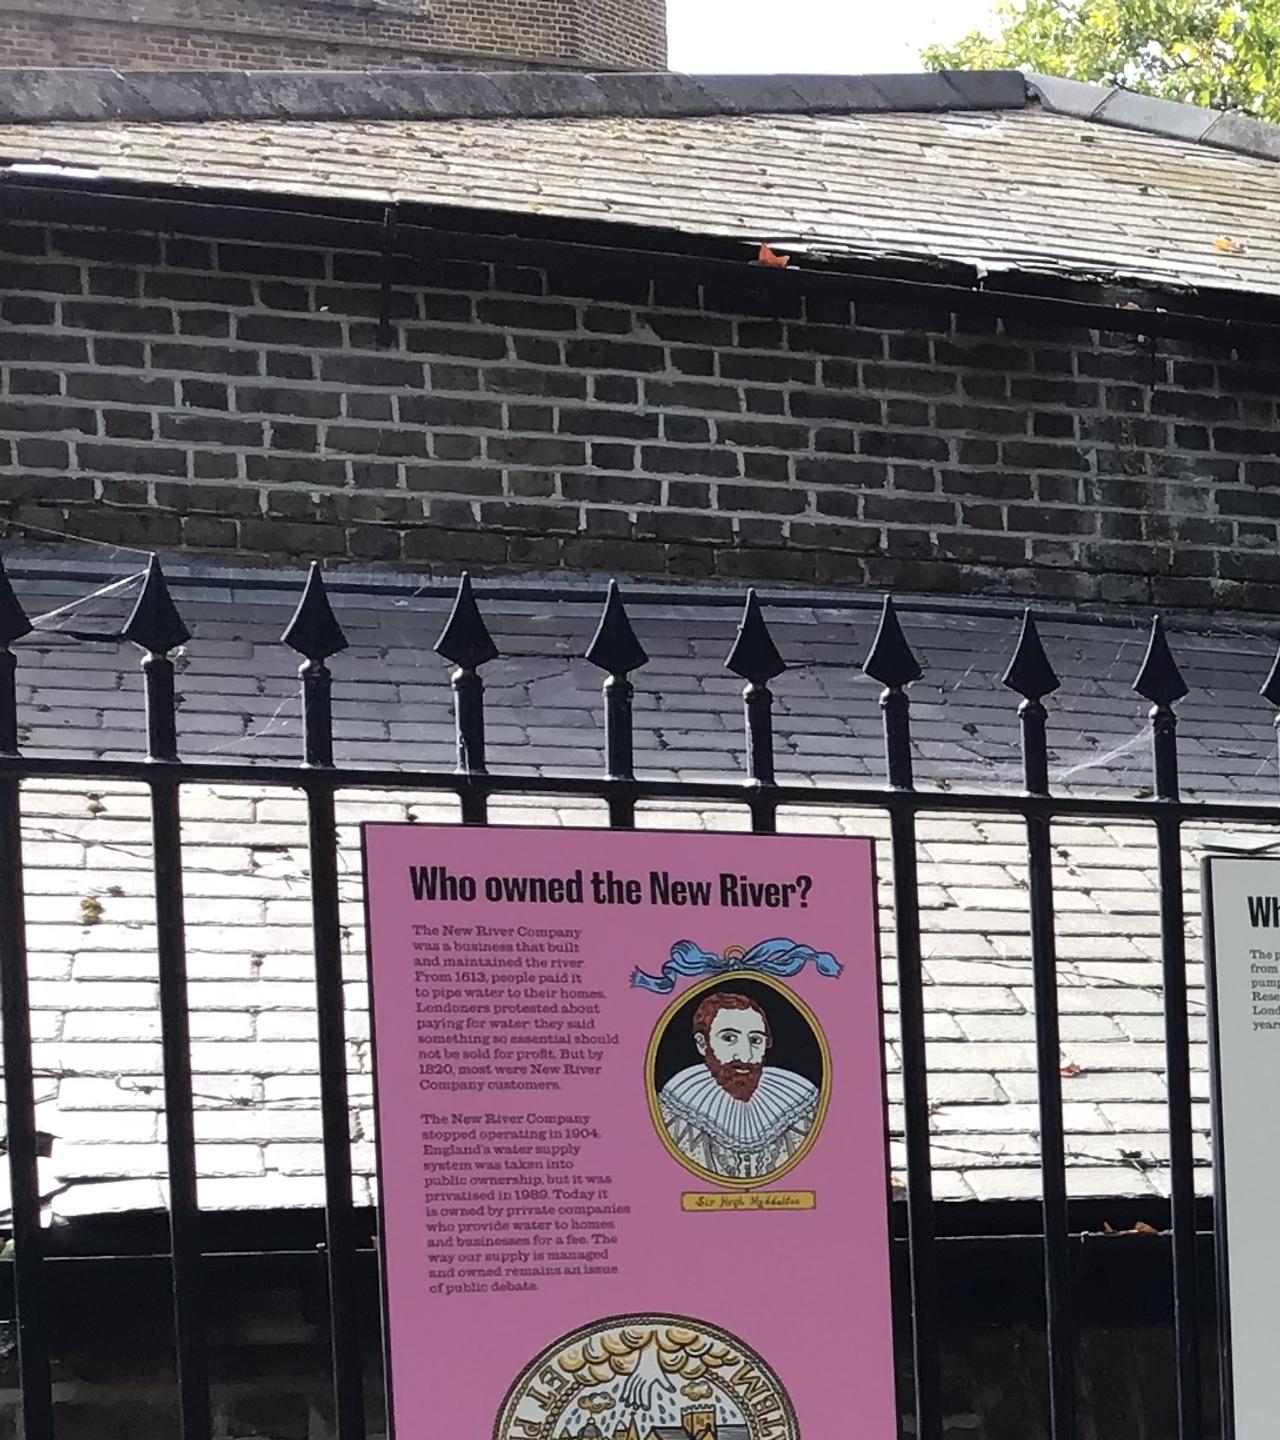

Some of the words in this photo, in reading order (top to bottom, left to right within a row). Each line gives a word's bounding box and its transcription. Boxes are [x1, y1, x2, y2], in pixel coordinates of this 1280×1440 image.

[410, 865, 477, 901] Who
[484, 867, 584, 903] owned
[591, 869, 642, 904] the
[649, 870, 712, 906] New
[719, 871, 813, 907] River?
[412, 926, 440, 936] The
[442, 926, 473, 936] New
[476, 926, 515, 937] River
[516, 927, 583, 939] Company
[412, 943, 440, 951] was
[442, 943, 452, 951] a
[453, 941, 514, 952] business
[515, 942, 545, 952] that
[547, 942, 580, 953] built
[1250, 950, 1273, 960] The
[414, 957, 440, 967] and
[442, 957, 523, 968] maintained
[524, 957, 548, 968] the
[1250, 964, 1278, 974] from
[414, 972, 452, 983] From
[490, 973, 536, 985] people
[537, 973, 569, 985] paid
[570, 973, 583, 983] it
[415, 988, 430, 998] to
[431, 988, 462, 1000] pipe
[463, 988, 505, 998] water
[506, 988, 521, 998] to
[523, 988, 558, 999] their
[416, 1003, 491, 1014] Londoners
[492, 1004, 559, 1016] protested
[560, 1004, 601, 1014] about
[416, 1018, 464, 1030] paying
[465, 1018, 486, 1028] for
[533, 1018, 564, 1031] they
[566, 1018, 595, 1029] said
[417, 1034, 491, 1046] something
[492, 1036, 508, 1044] so
[509, 1034, 572, 1044] essential
[573, 1034, 620, 1044] should
[418, 1050, 442, 1060] not
[443, 1050, 460, 1060] be
[462, 1050, 491, 1060] sold
[493, 1050, 514, 1060] for
[560, 1050, 586, 1060] But
[587, 1050, 604, 1062] by
[457, 1064, 492, 1075] most
[494, 1067, 528, 1075] were
[530, 1064, 561, 1075] New
[563, 1064, 602, 1075] River
[419, 1080, 485, 1092] Company
[420, 1114, 449, 1124] The
[451, 1114, 482, 1124] New
[484, 1114, 524, 1124] River
[525, 1114, 591, 1126] Company
[422, 1129, 477, 1142] stopped
[478, 1129, 547, 1141] operating
[548, 1129, 563, 1139] in
[695, 1196, 715, 1207] Sir
